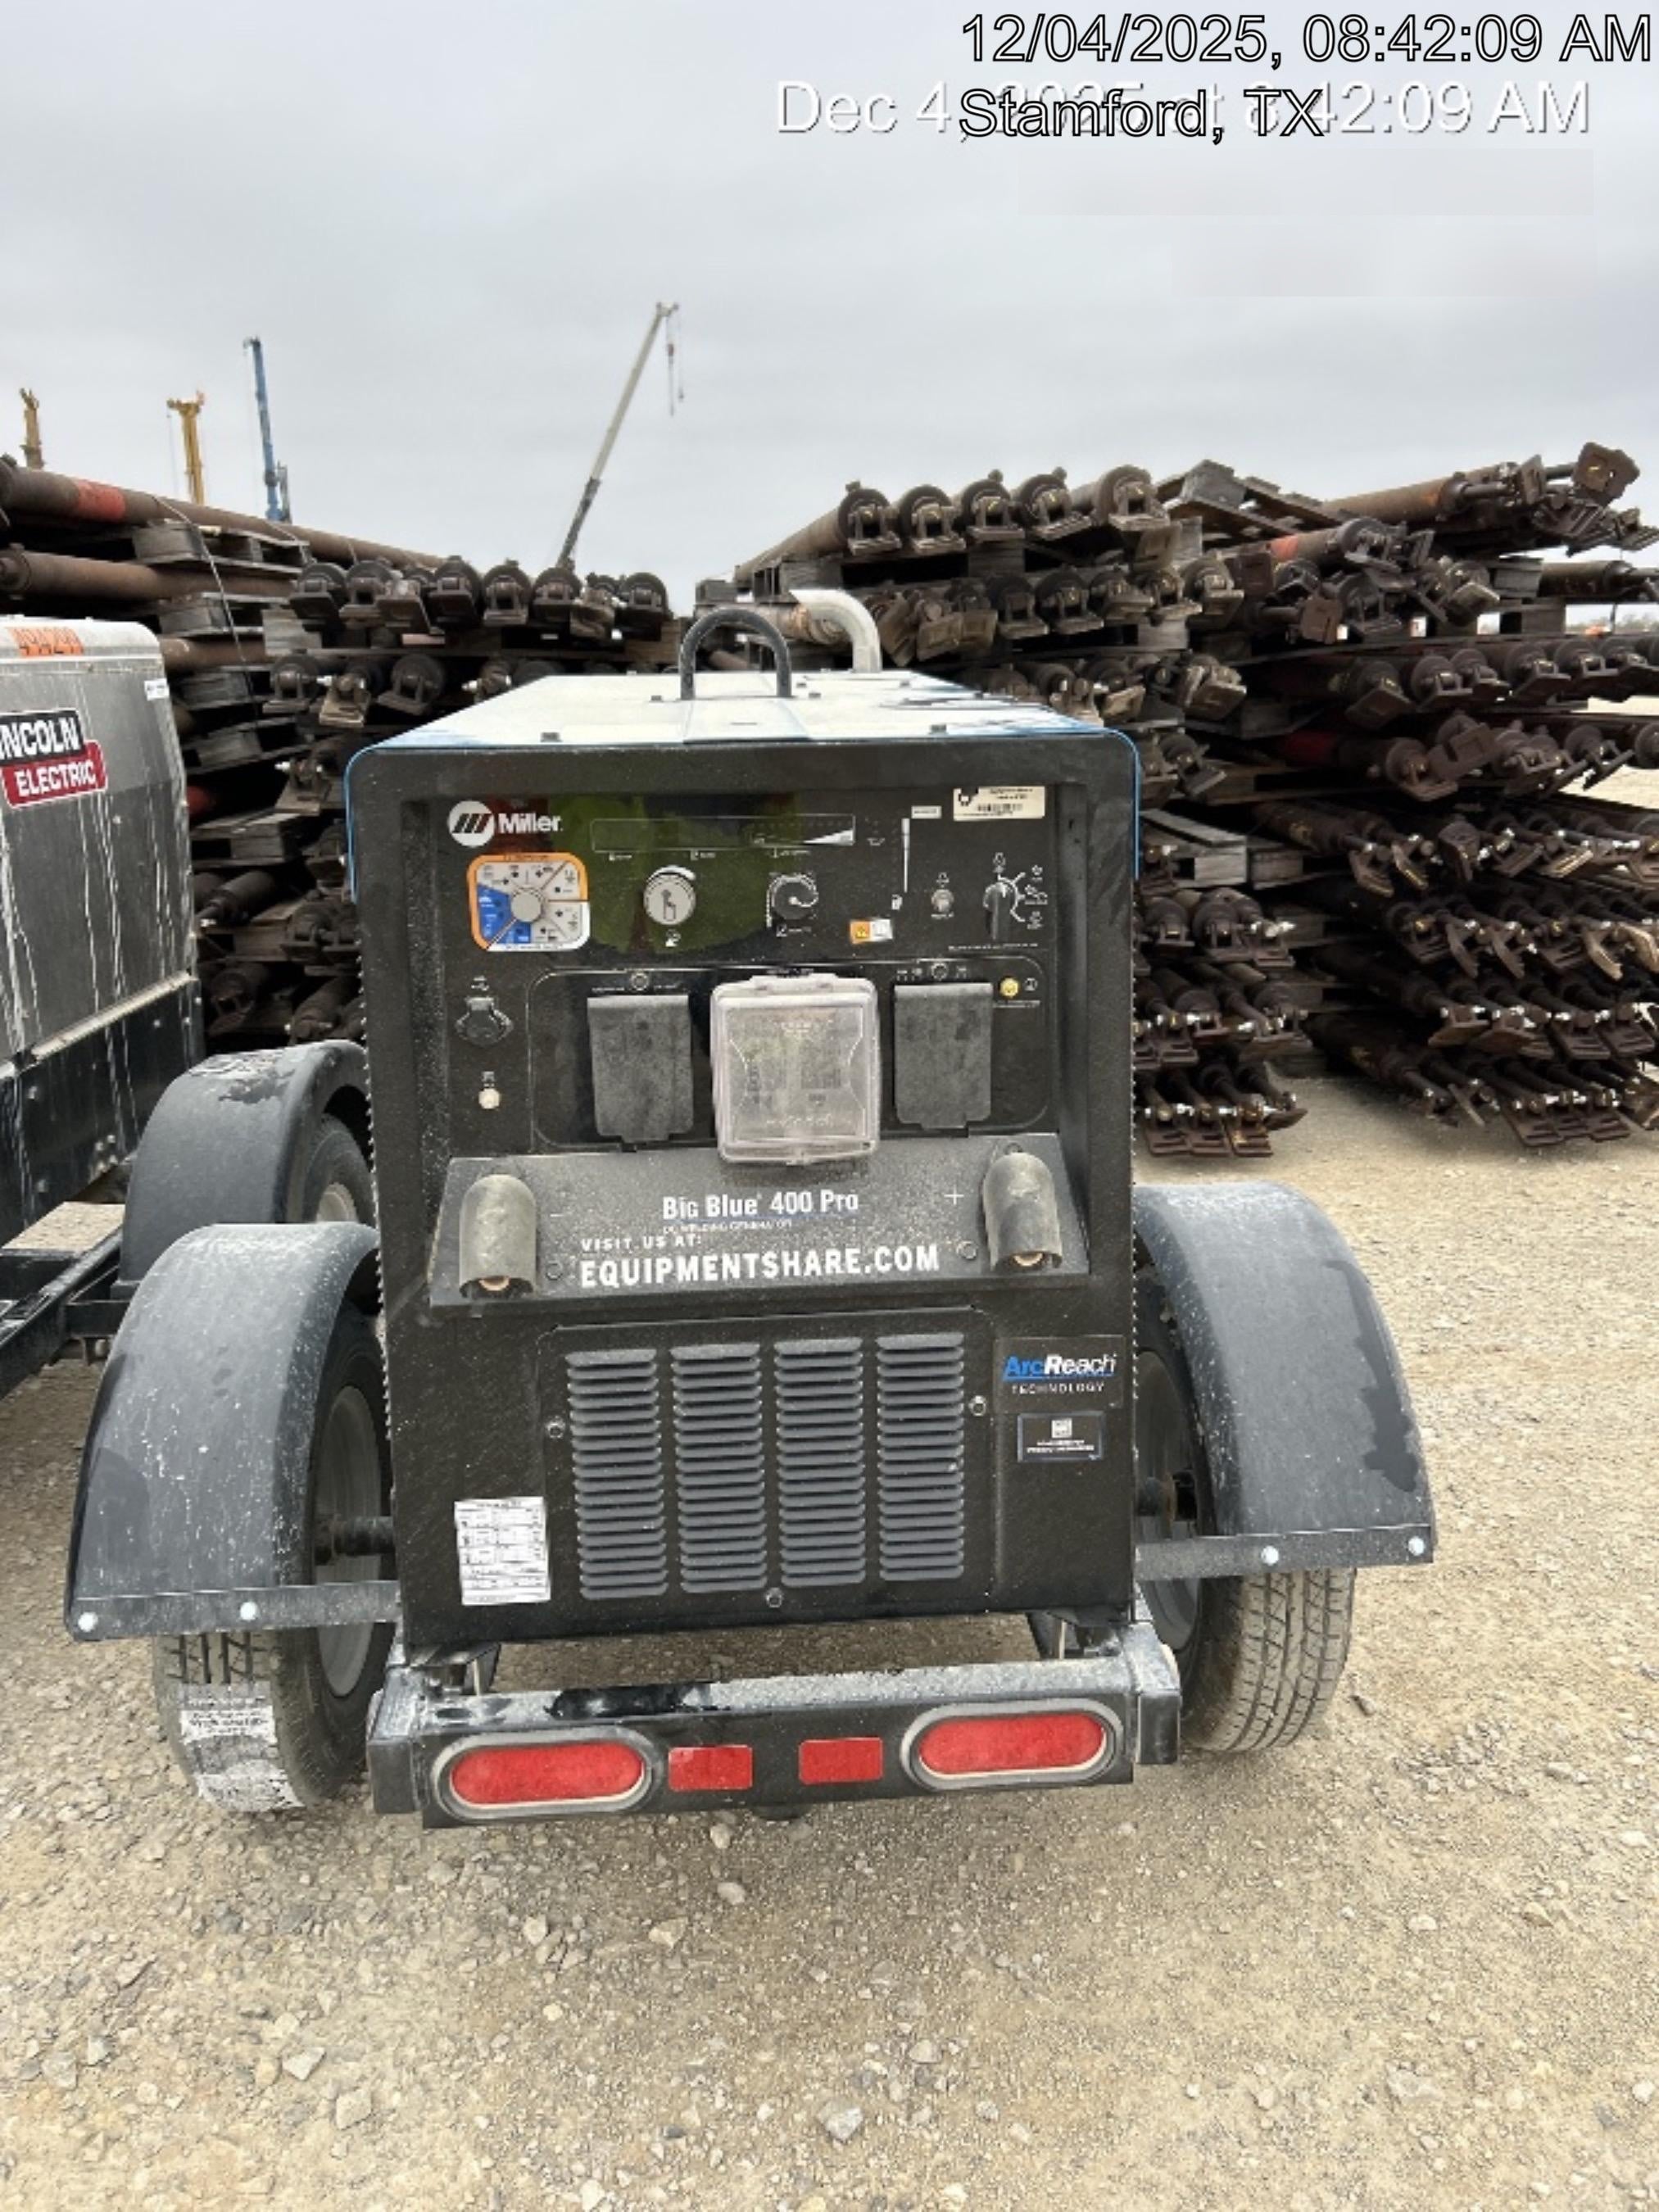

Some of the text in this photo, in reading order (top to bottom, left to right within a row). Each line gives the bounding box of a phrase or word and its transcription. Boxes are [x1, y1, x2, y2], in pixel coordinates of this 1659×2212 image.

[15, 760, 97, 796] ELECTRIC
[662, 1196, 699, 1220] Big
[770, 1190, 813, 1215] 400
[820, 1188, 859, 1213] Pro
[581, 1234, 702, 1252] VISIT US AT:
[581, 1243, 941, 1289] EQUIPMENTSHARE.COM
[1003, 1353, 1117, 1377] ArcReach
